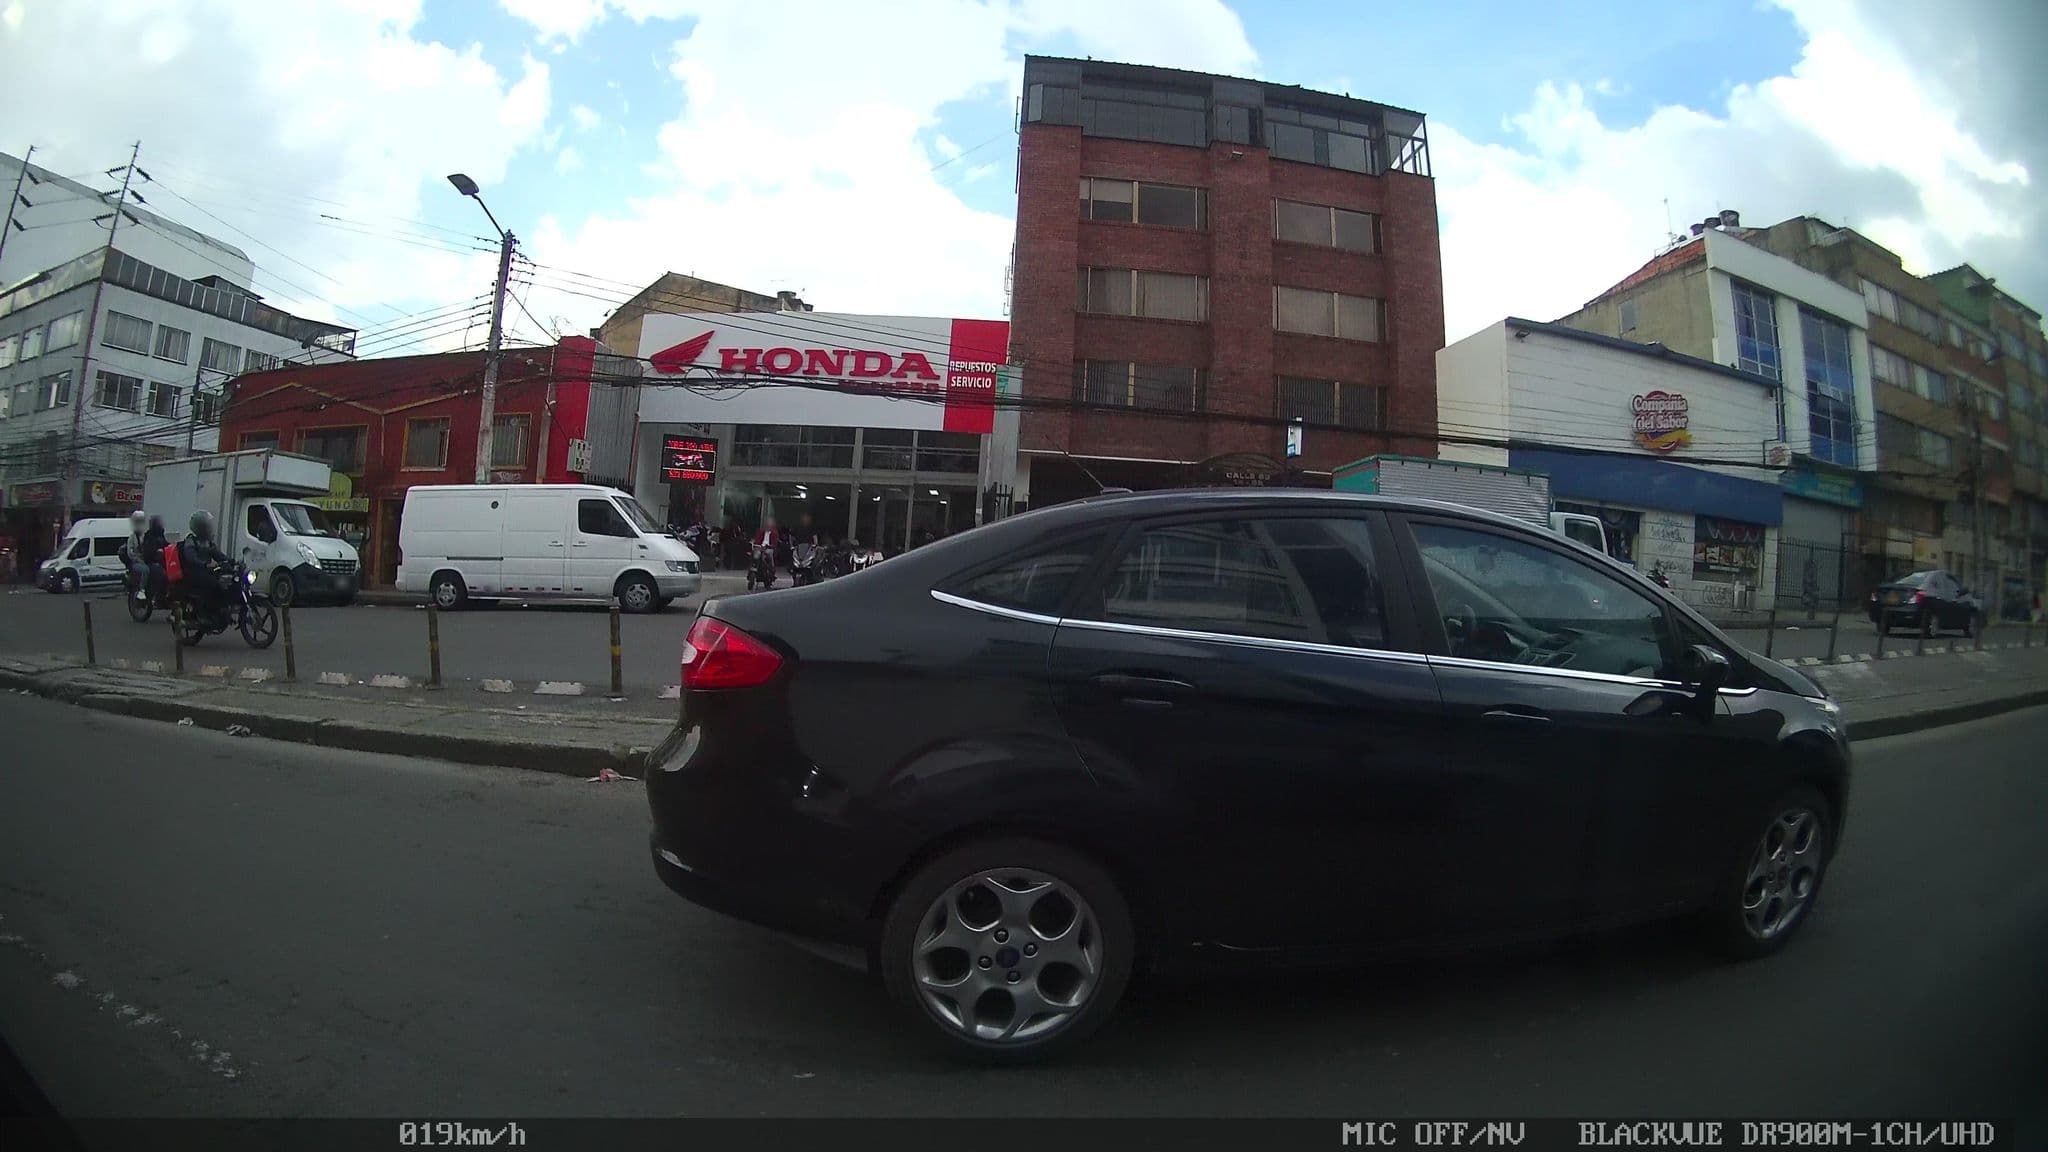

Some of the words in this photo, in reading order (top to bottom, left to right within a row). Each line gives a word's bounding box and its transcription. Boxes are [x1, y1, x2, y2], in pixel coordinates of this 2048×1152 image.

[717, 347, 941, 380] HONDA
[949, 360, 996, 373] REPUESTOS
[951, 376, 992, 388] SERVICIO
[1637, 415, 1654, 429] del
[1656, 414, 1688, 428] Sabor
